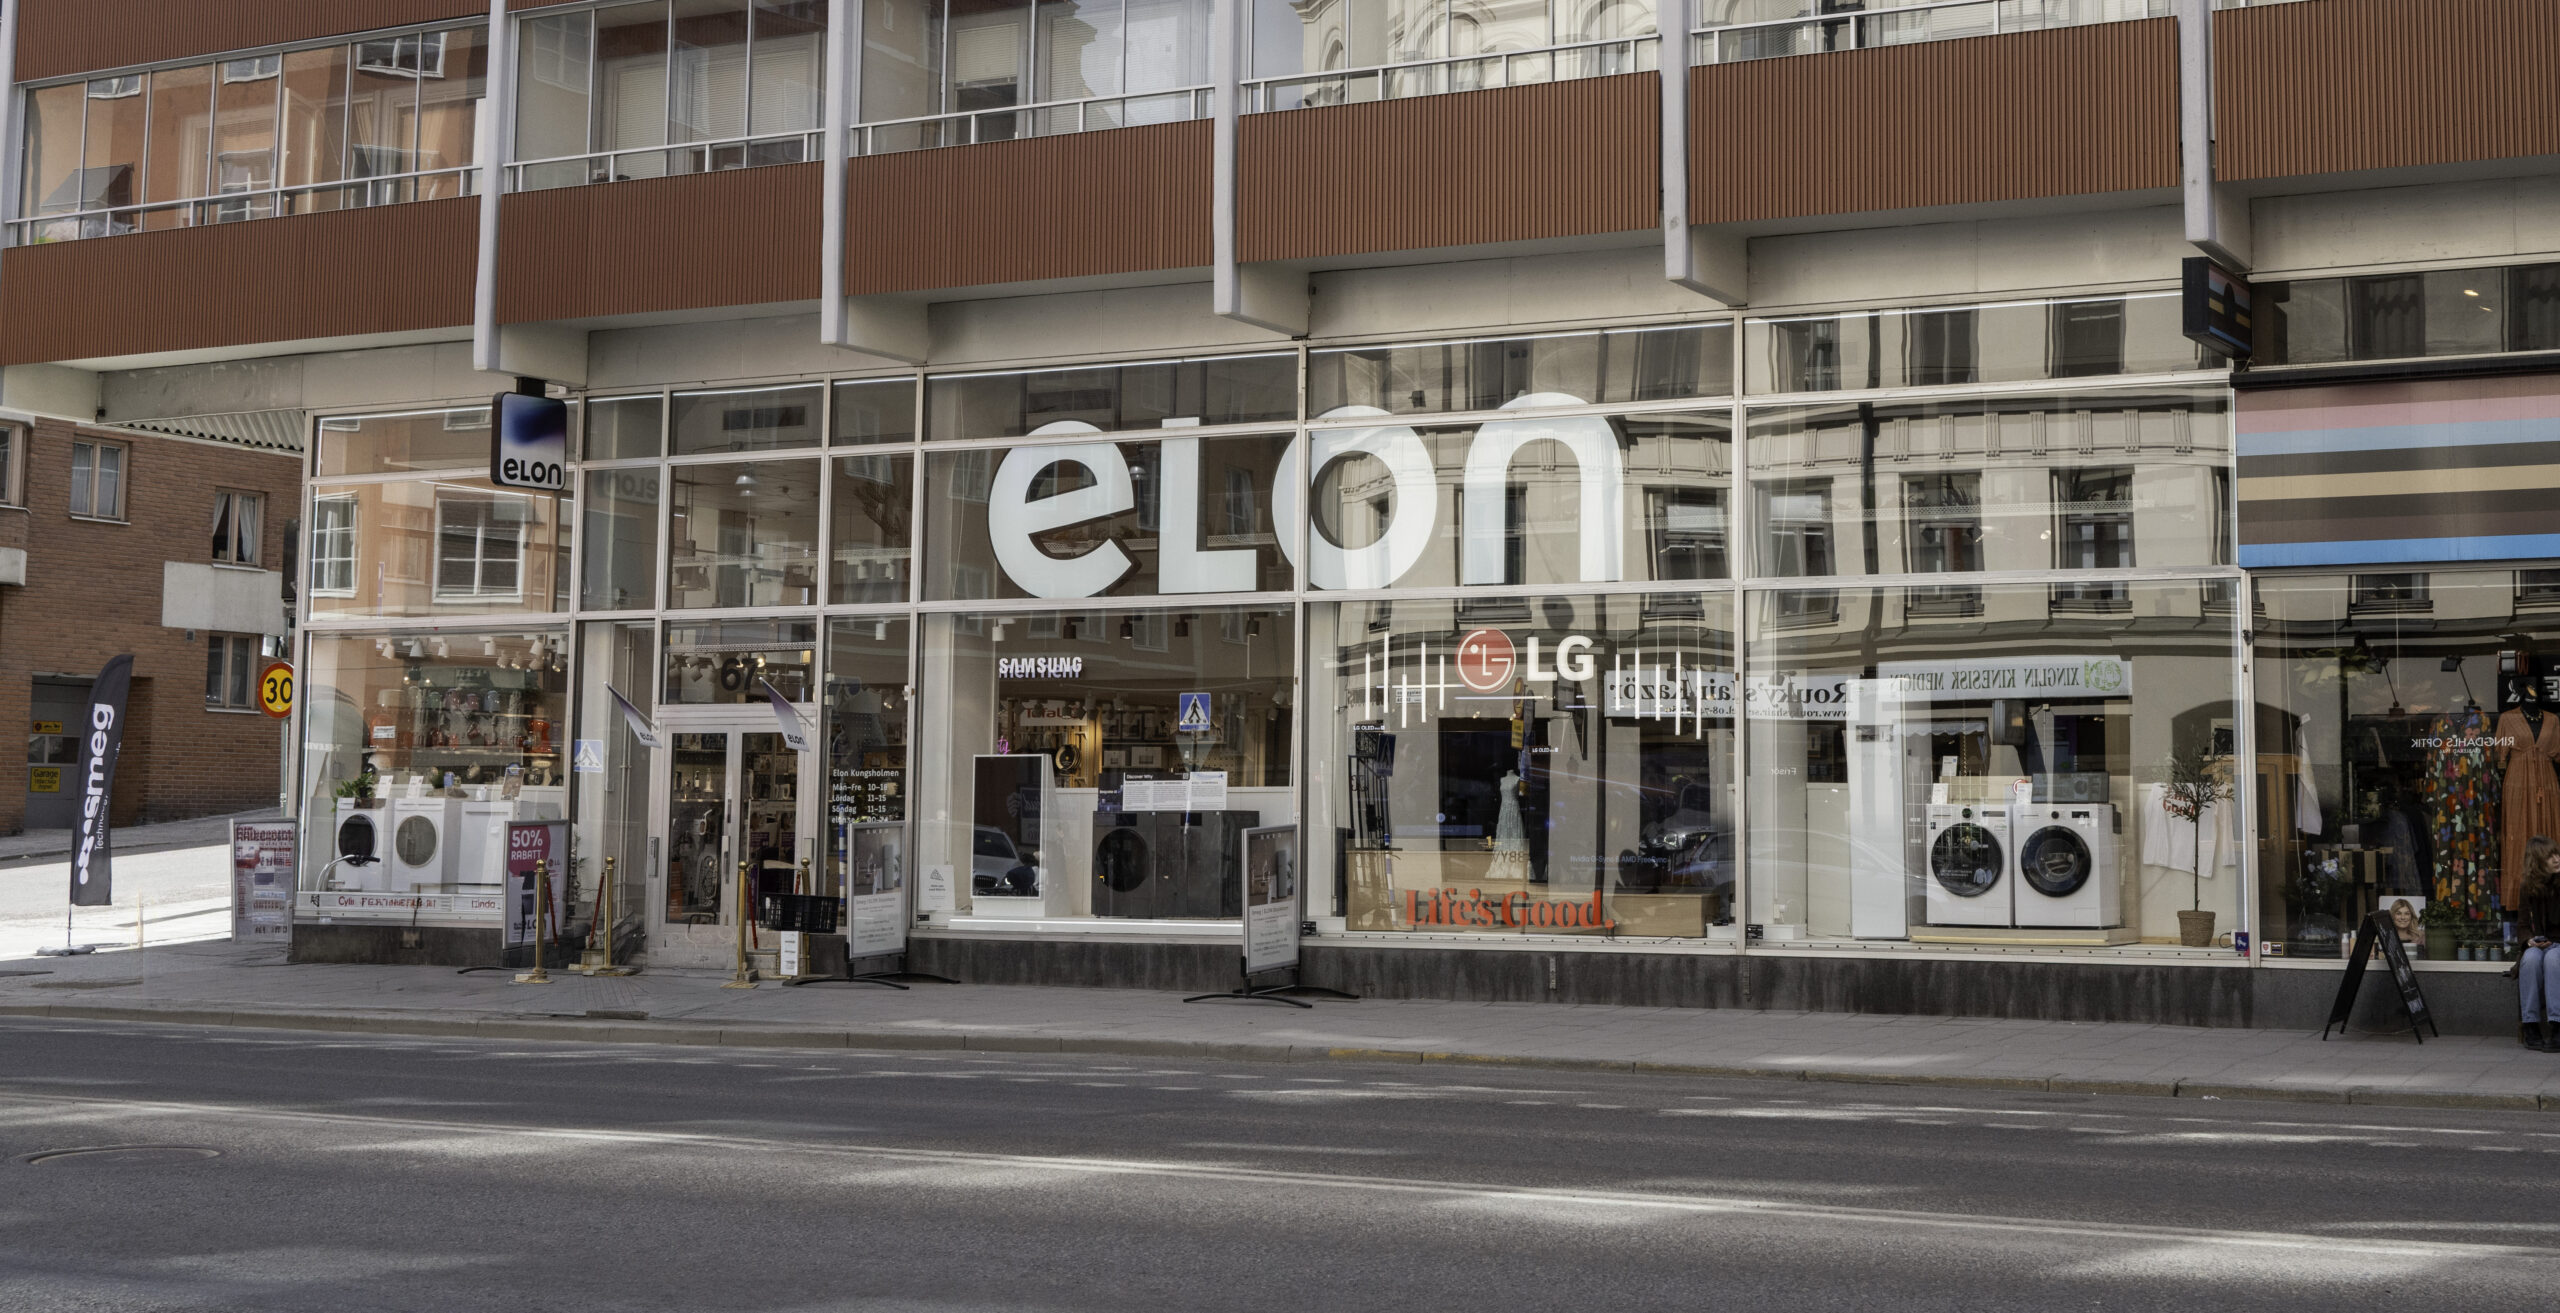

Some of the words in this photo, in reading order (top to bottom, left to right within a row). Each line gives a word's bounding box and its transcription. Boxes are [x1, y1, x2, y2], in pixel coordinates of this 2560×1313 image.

[998, 656, 1082, 674] SAMSUNG
[1527, 635, 1594, 681] LG
[721, 657, 758, 691] 67
[265, 677, 293, 704] 30
[1026, 707, 1063, 718] Tfal
[84, 703, 115, 819] smeg
[34, 768, 58, 780] Garage
[833, 769, 849, 777] Elon
[850, 769, 899, 778] Kungsholmen
[832, 794, 855, 803] Lördag
[832, 805, 857, 815] Söndag
[511, 829, 543, 848] 50%
[511, 849, 542, 860] RABATT
[1621, 855, 1636, 863] AMD
[1637, 855, 1668, 864] FreeSync
[1405, 887, 1494, 928] Life's
[1501, 889, 1615, 929] Good.
